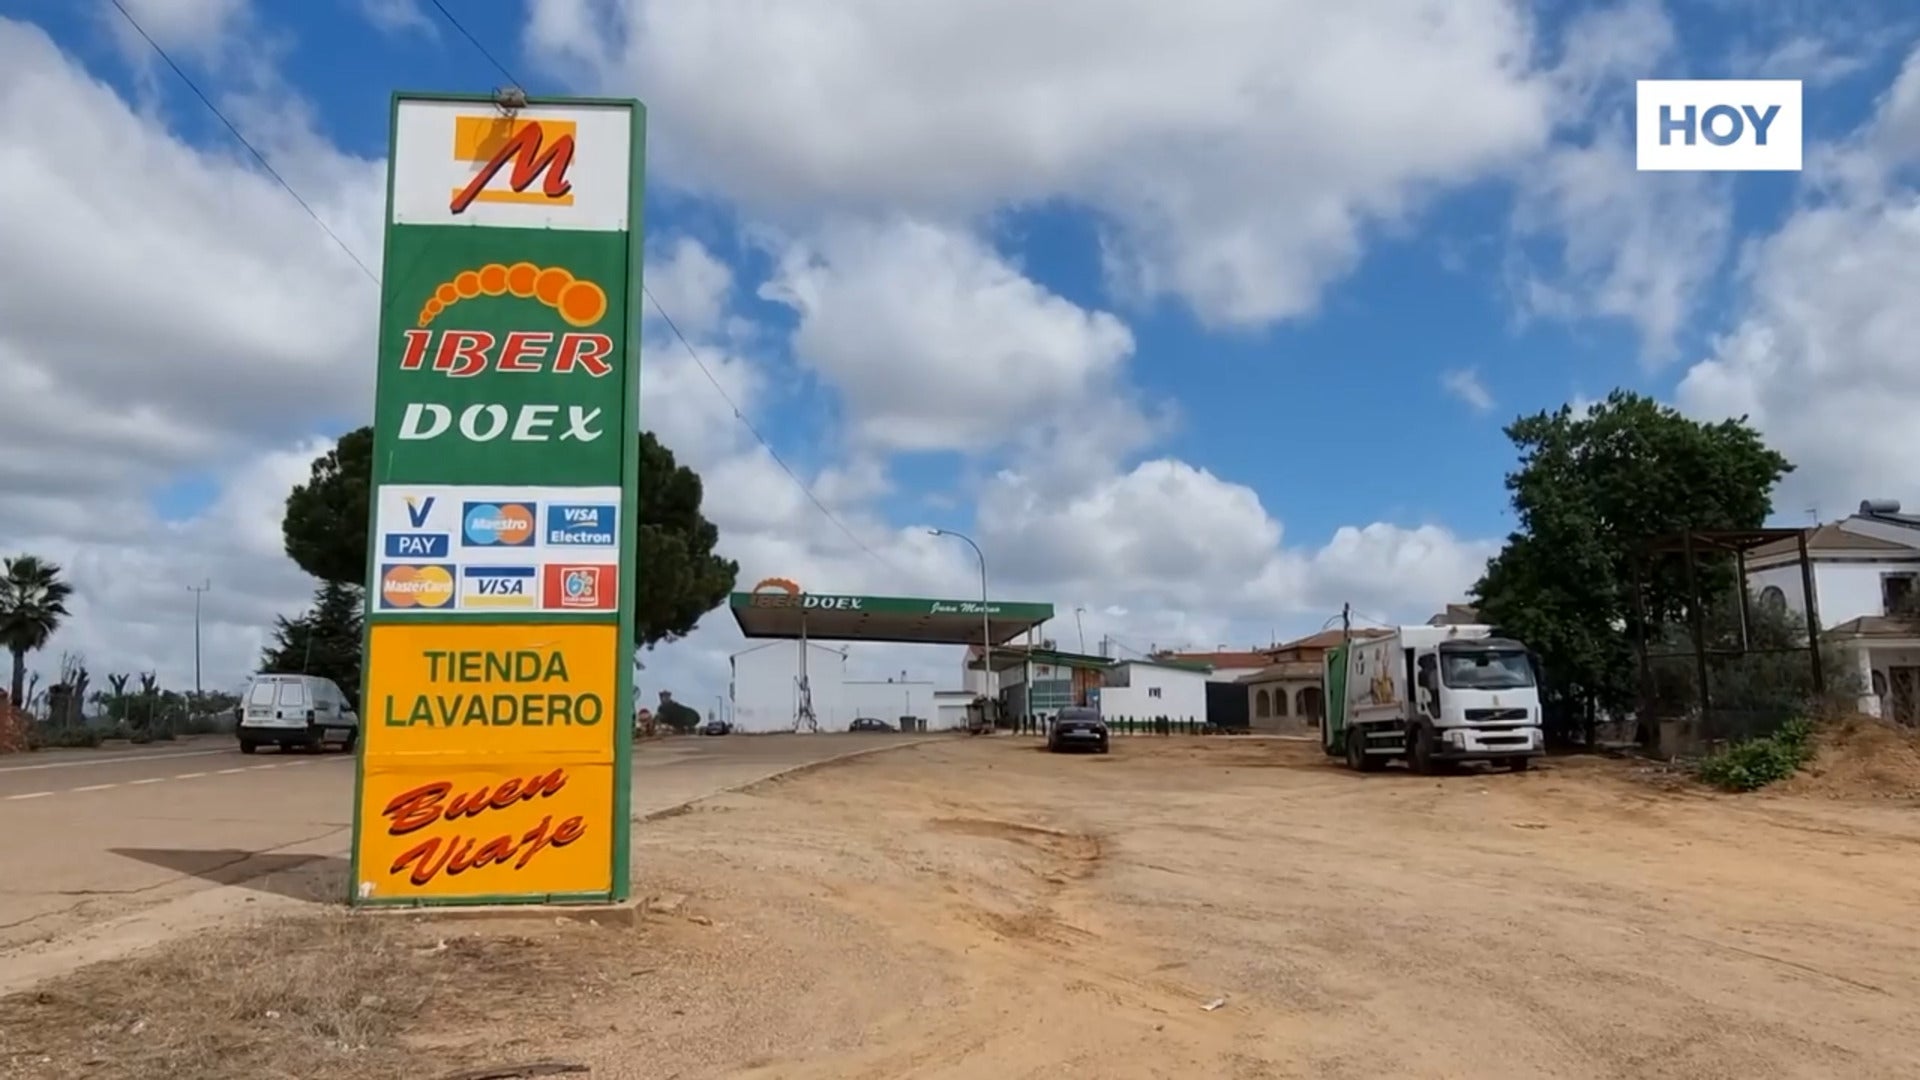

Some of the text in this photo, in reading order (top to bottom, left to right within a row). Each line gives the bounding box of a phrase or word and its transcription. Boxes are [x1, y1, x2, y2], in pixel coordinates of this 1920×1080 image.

[450, 121, 575, 215] M
[400, 330, 614, 378] IBER
[398, 403, 604, 442] DOEX
[404, 496, 436, 528] V
[471, 517, 528, 530] Maestro
[564, 508, 598, 521] VISA
[399, 537, 437, 554] PAY
[551, 531, 611, 544] Electron
[384, 578, 453, 592] MasterCard
[478, 578, 524, 595] VISA
[803, 596, 862, 610] DOEX
[423, 651, 569, 683] TIENDA
[385, 693, 603, 727] LAVADERO
[382, 767, 569, 835] Buen
[390, 815, 588, 886] Viaje
